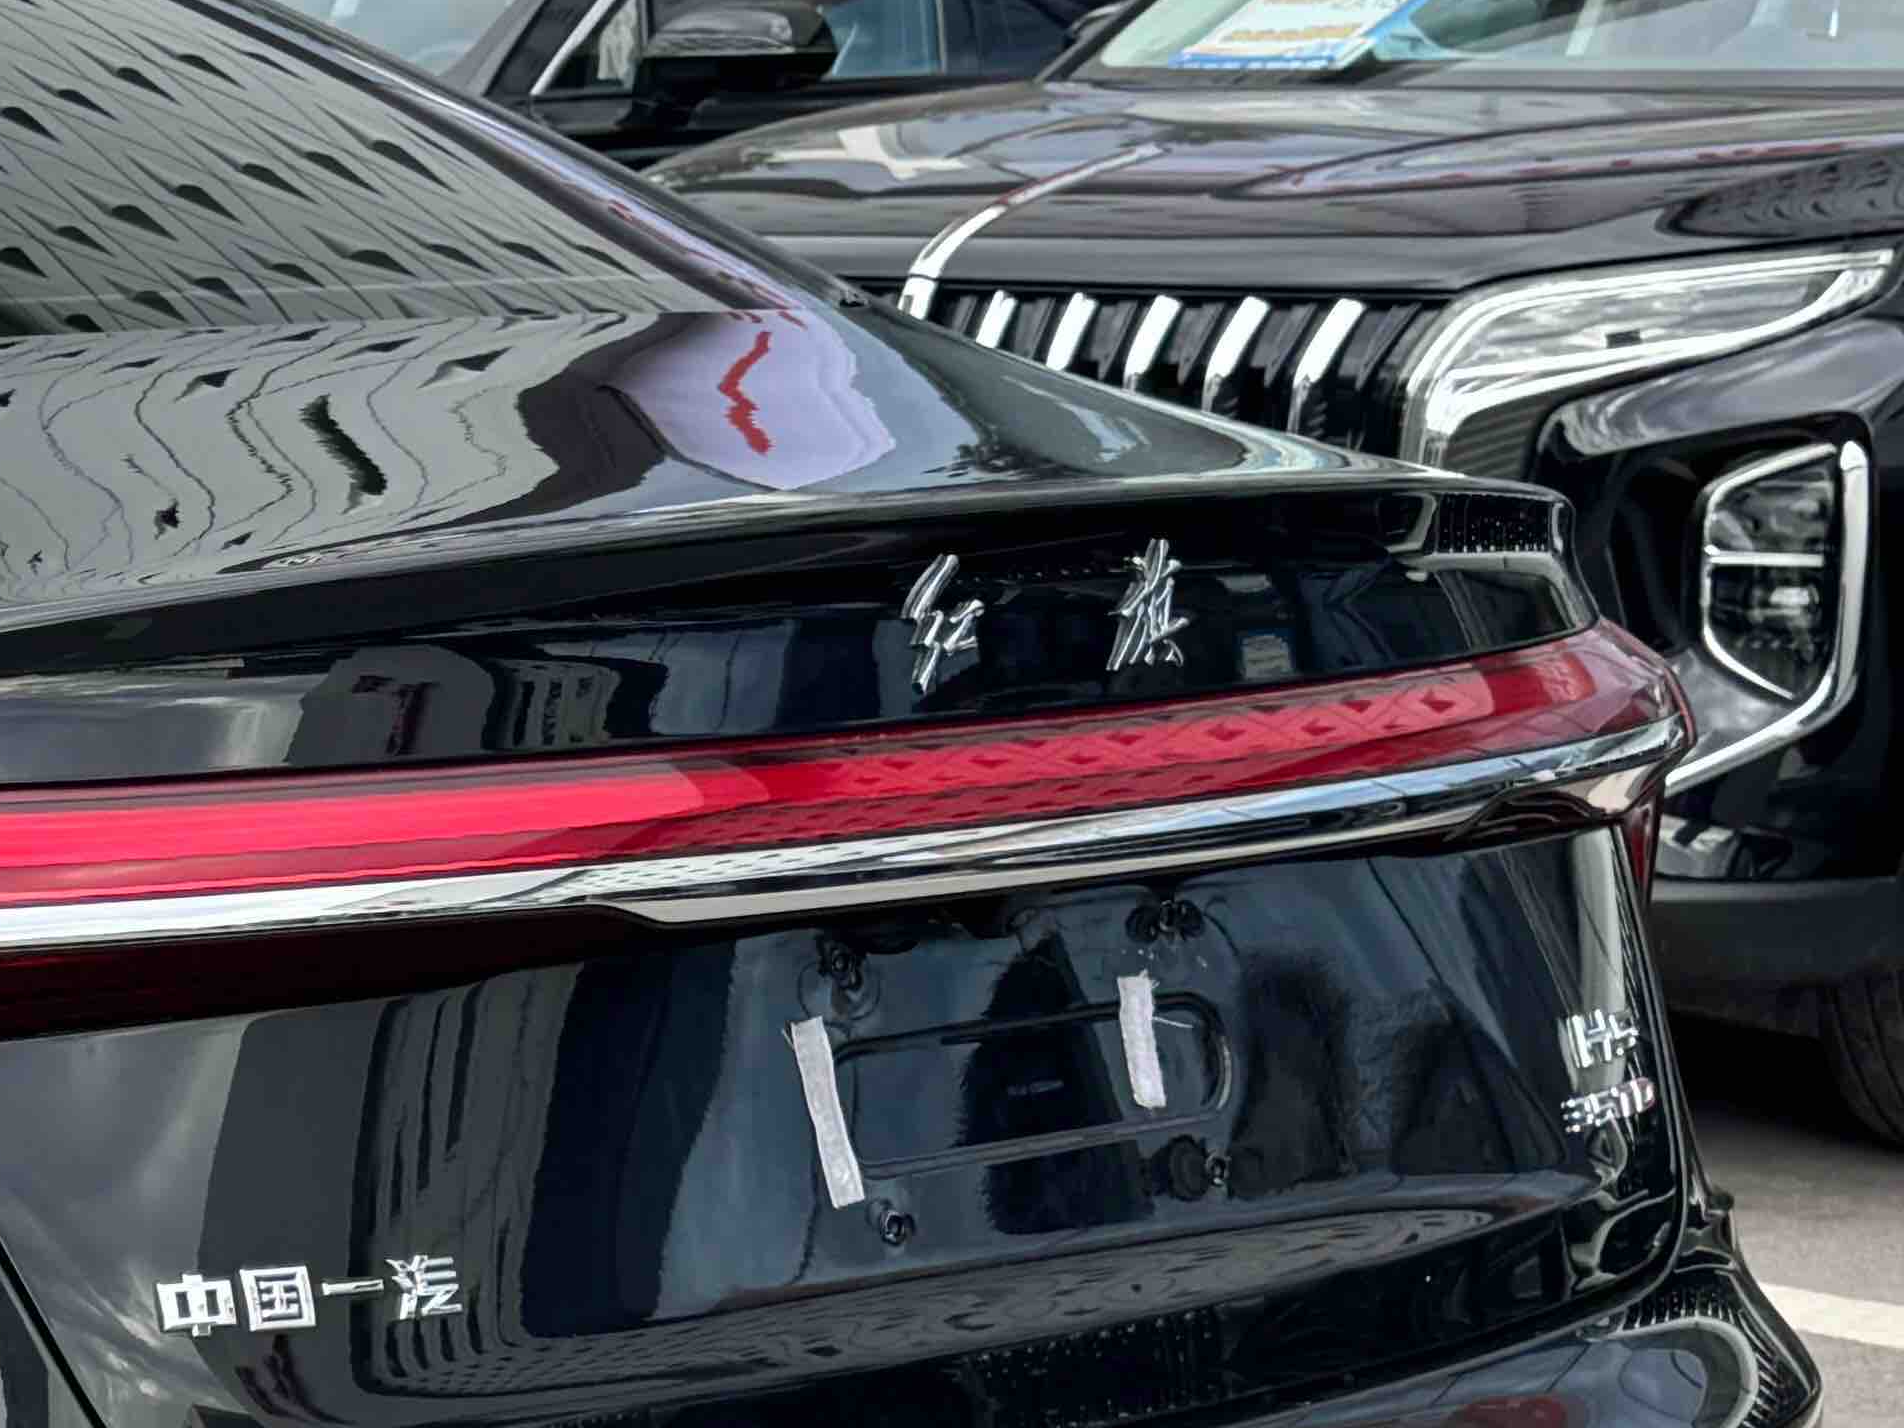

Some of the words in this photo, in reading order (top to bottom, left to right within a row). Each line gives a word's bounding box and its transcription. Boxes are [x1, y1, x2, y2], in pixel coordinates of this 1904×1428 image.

[901, 537, 1189, 694] 红旗
[156, 1254, 463, 1337] 中国一汽
